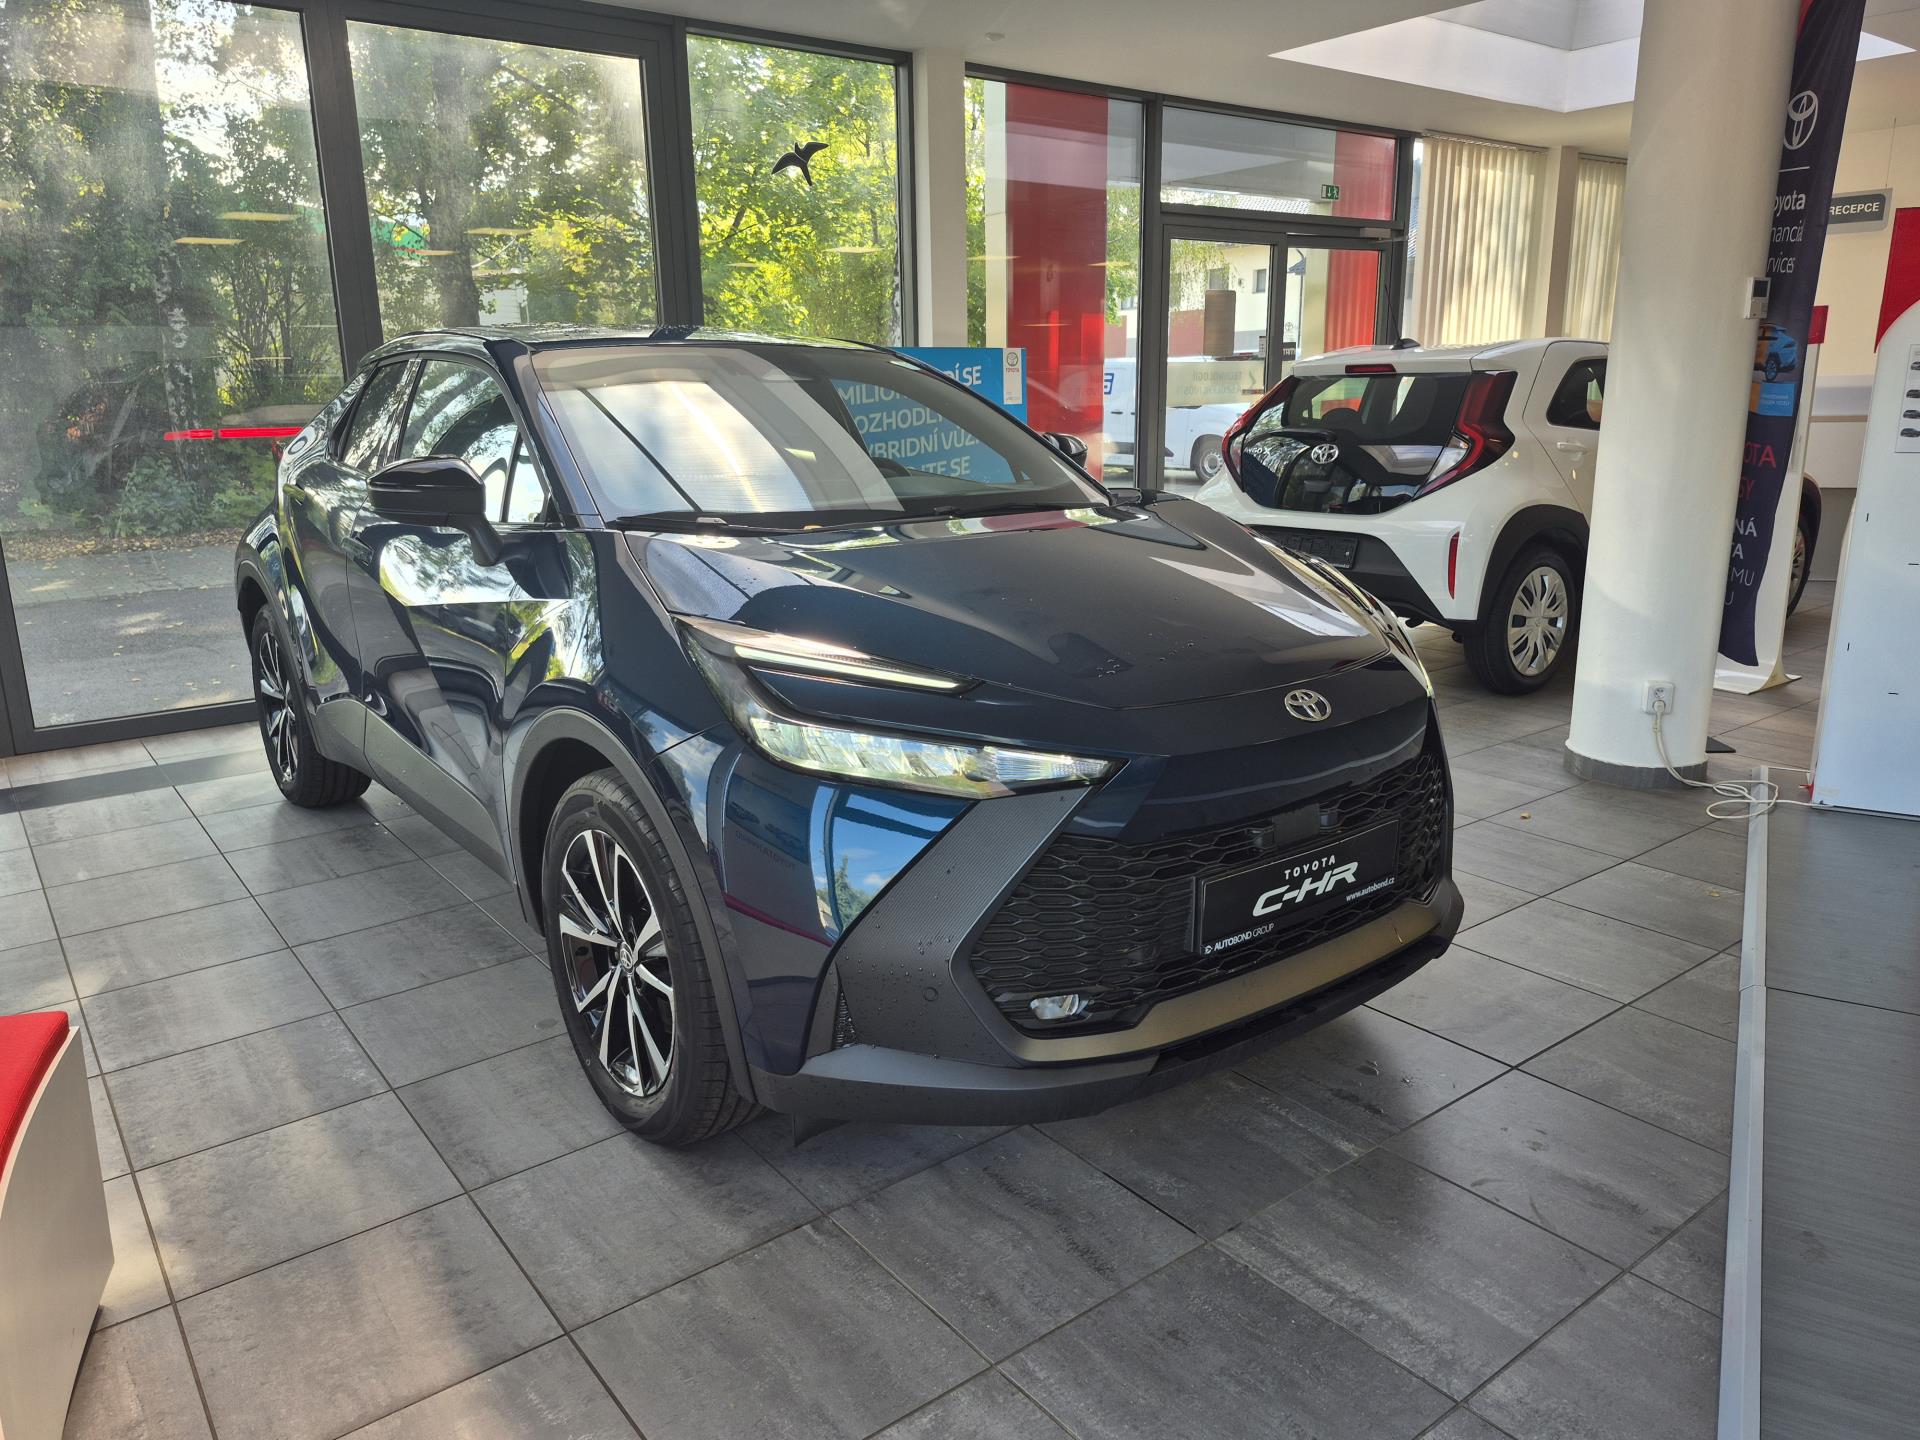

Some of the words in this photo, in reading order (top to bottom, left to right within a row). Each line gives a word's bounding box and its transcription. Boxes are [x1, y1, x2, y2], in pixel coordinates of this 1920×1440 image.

[1829, 202, 1880, 215] RECEPCE
[962, 365, 982, 387] SE
[838, 384, 908, 406] MILIO
[854, 406, 943, 435] OZHODL
[951, 455, 970, 477] SE
[1284, 855, 1336, 880] TOYOTA
[1252, 861, 1359, 917] C-HR
[1346, 877, 1395, 902] www.autobond.cz
[1213, 930, 1253, 952] AUTOBOND
[1252, 922, 1275, 938] GROUP
